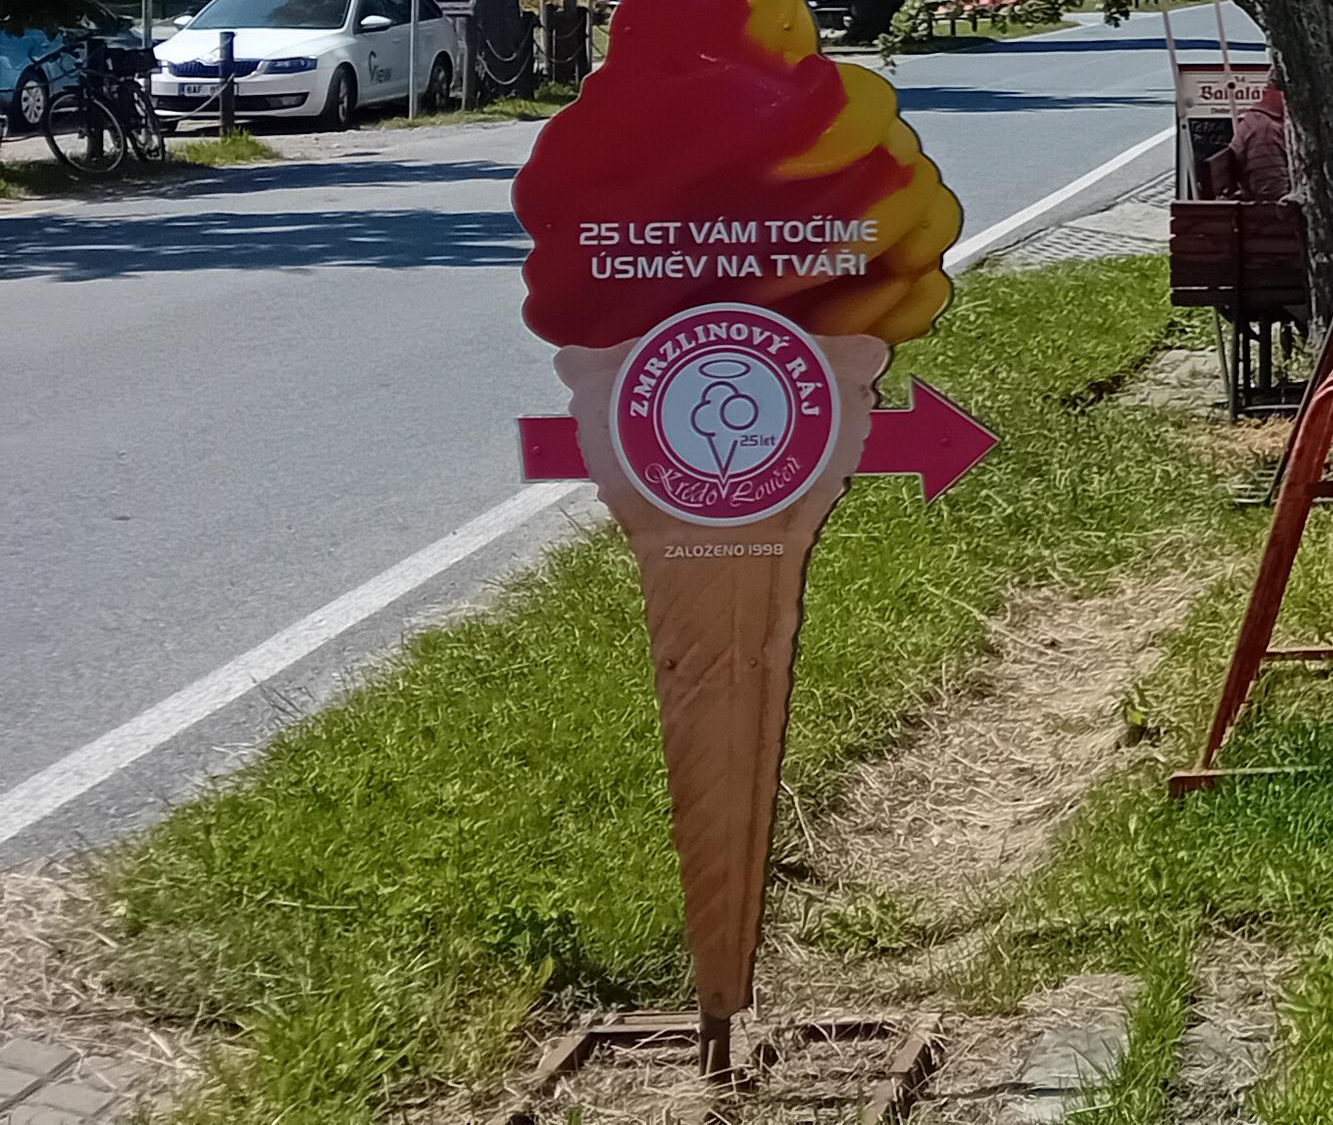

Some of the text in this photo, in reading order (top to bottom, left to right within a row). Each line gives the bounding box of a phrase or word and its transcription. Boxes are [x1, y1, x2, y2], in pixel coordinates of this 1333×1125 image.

[1198, 85, 1261, 101] Baalá
[579, 215, 879, 245] 25 LET VÁM TOČÍME
[591, 249, 867, 279] ÚSMĚV NA TVÁŘI
[629, 322, 824, 418] ZMRZLINOVÝ RÁJ
[748, 542, 785, 557] 1998
